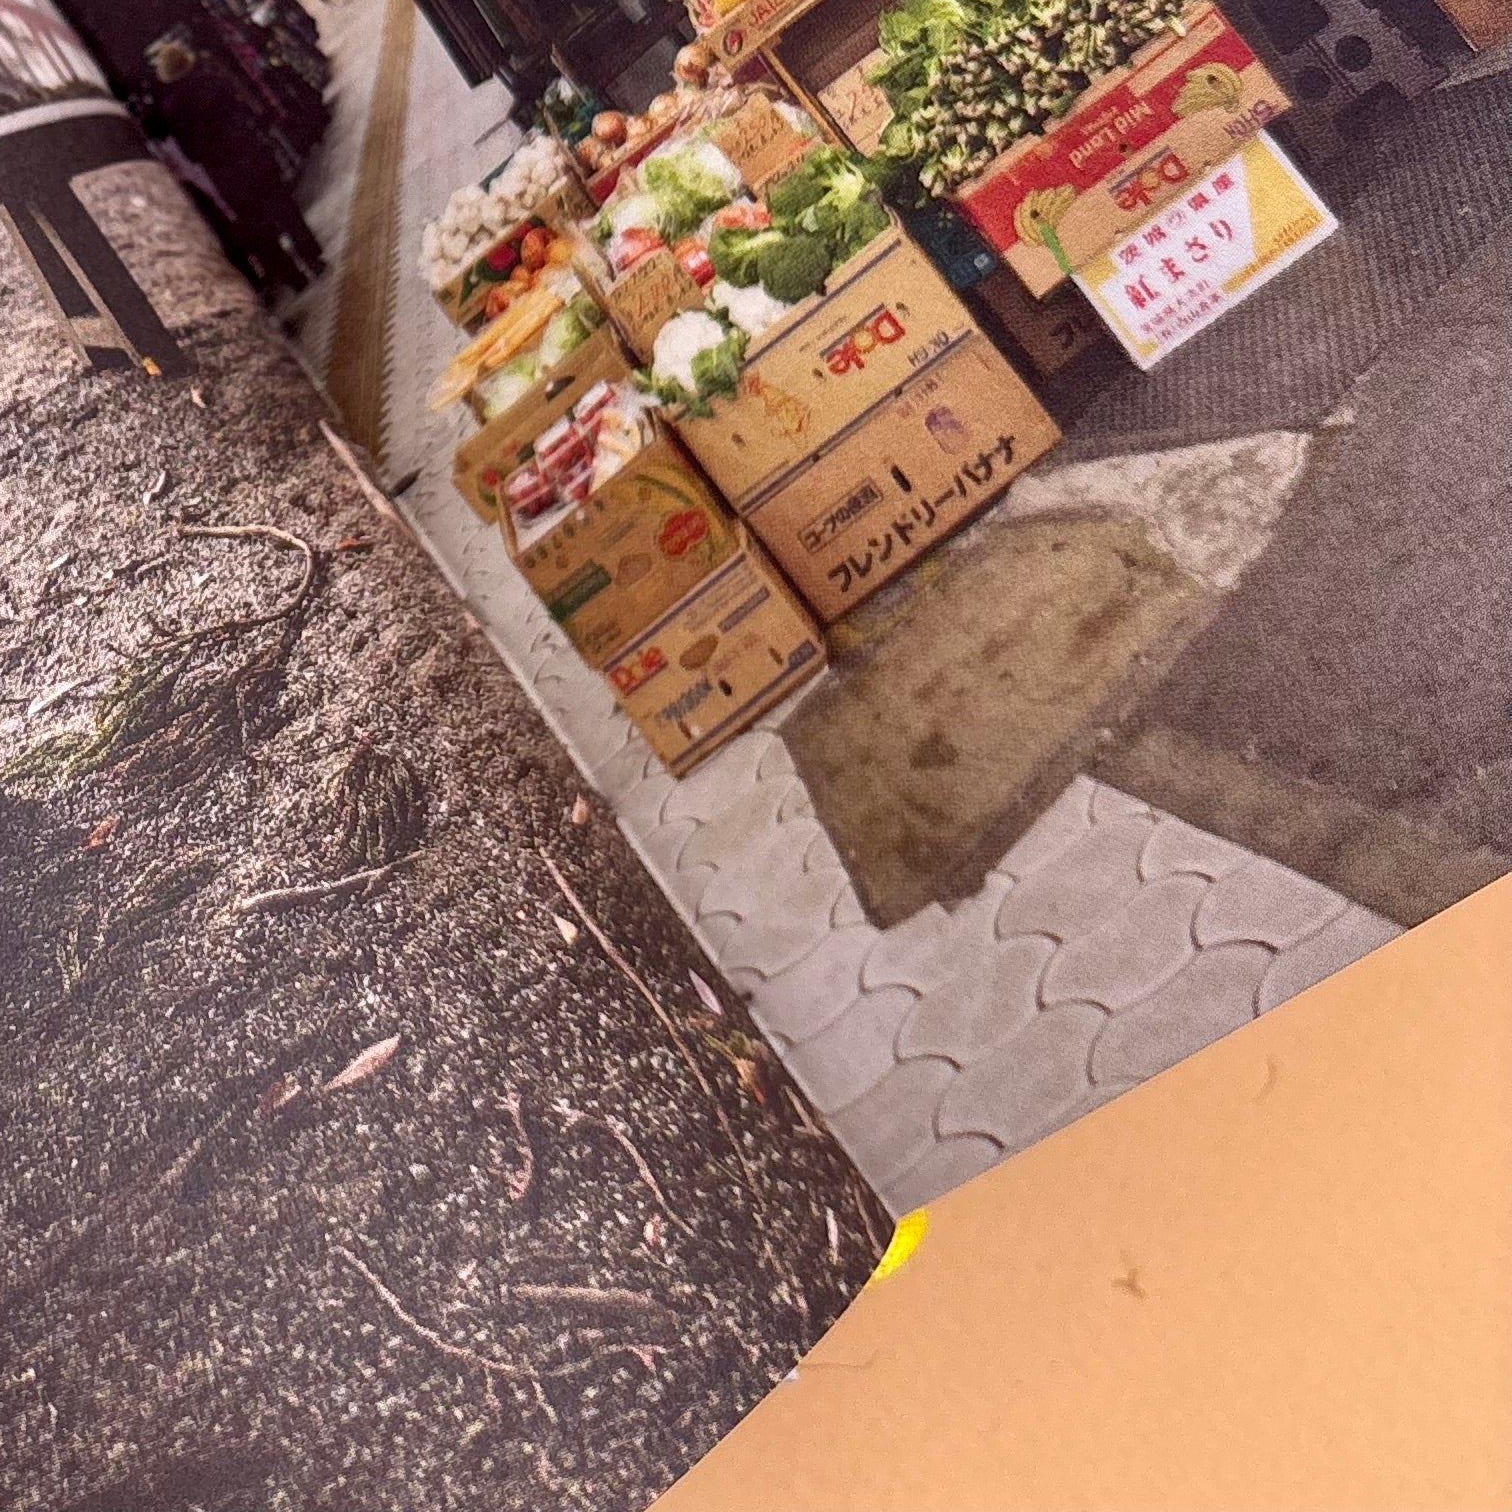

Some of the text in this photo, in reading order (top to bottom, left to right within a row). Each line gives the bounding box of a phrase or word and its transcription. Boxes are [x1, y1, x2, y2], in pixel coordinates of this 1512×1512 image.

[1068, 126, 1116, 168] Land
[1113, 101, 1153, 135] Mid
[1115, 152, 1189, 213] Dole
[1124, 218, 1234, 309] 紅まさり
[824, 311, 905, 377] Dole
[827, 433, 1014, 592] フレンドリーバナナ
